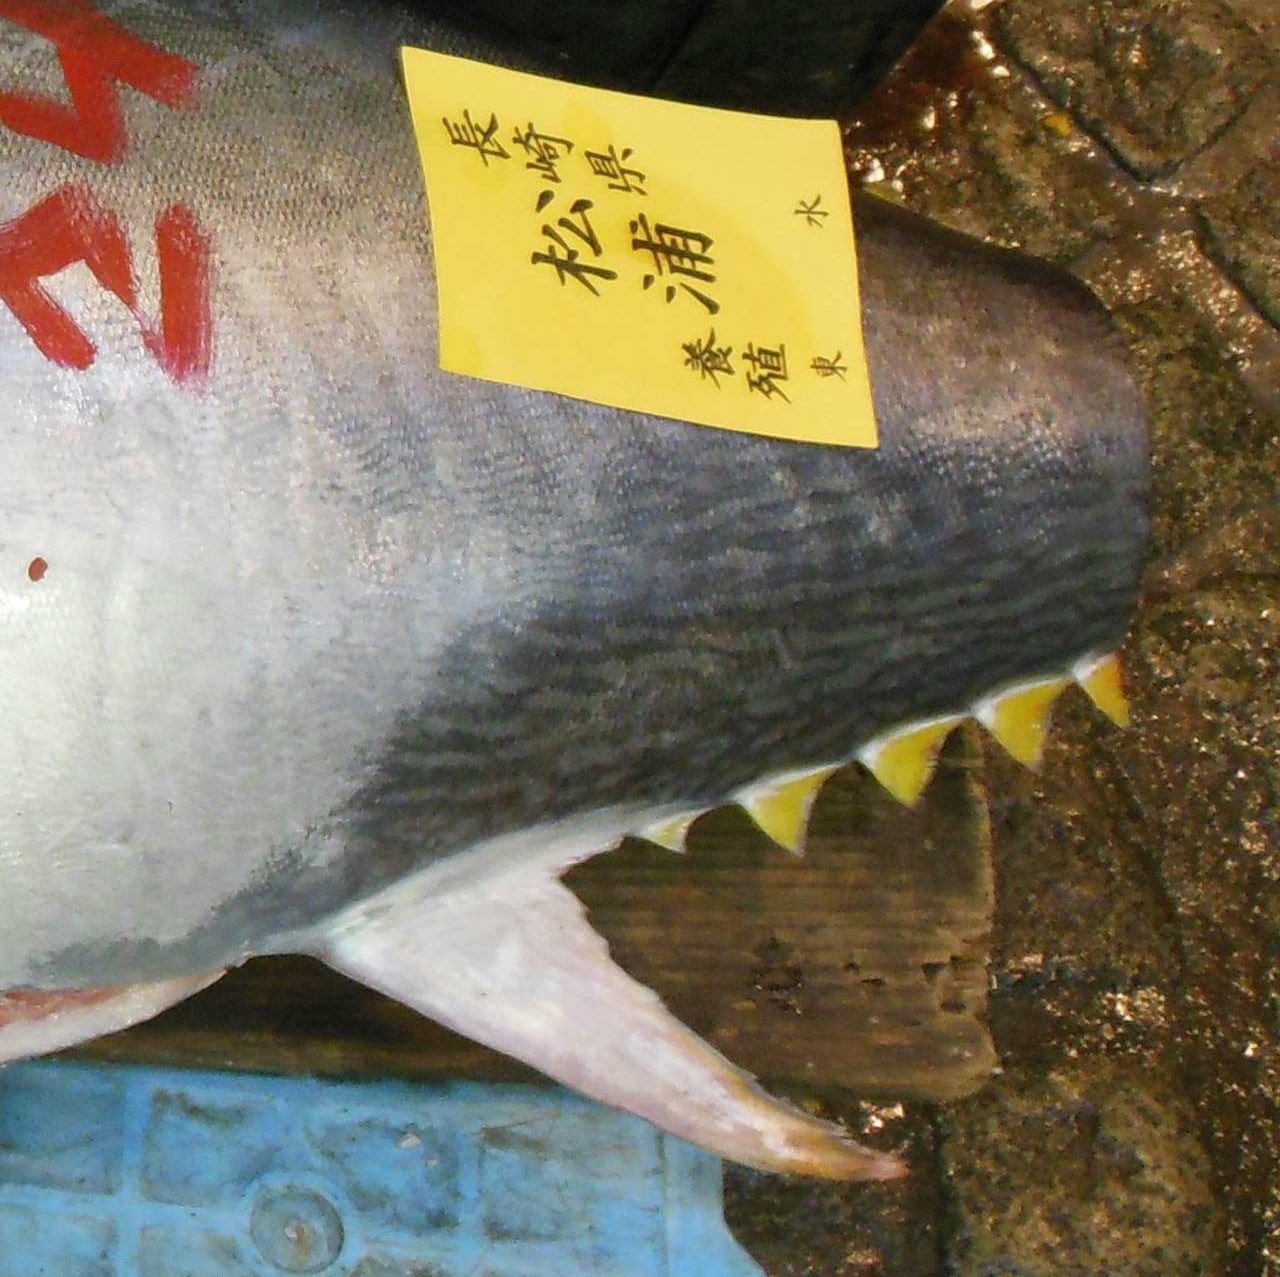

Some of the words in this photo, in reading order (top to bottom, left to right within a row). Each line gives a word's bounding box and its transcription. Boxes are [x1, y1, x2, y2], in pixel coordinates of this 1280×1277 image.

[443, 109, 647, 195] 長崎県
[531, 190, 720, 314] 松浦
[681, 327, 791, 403] 養殖
